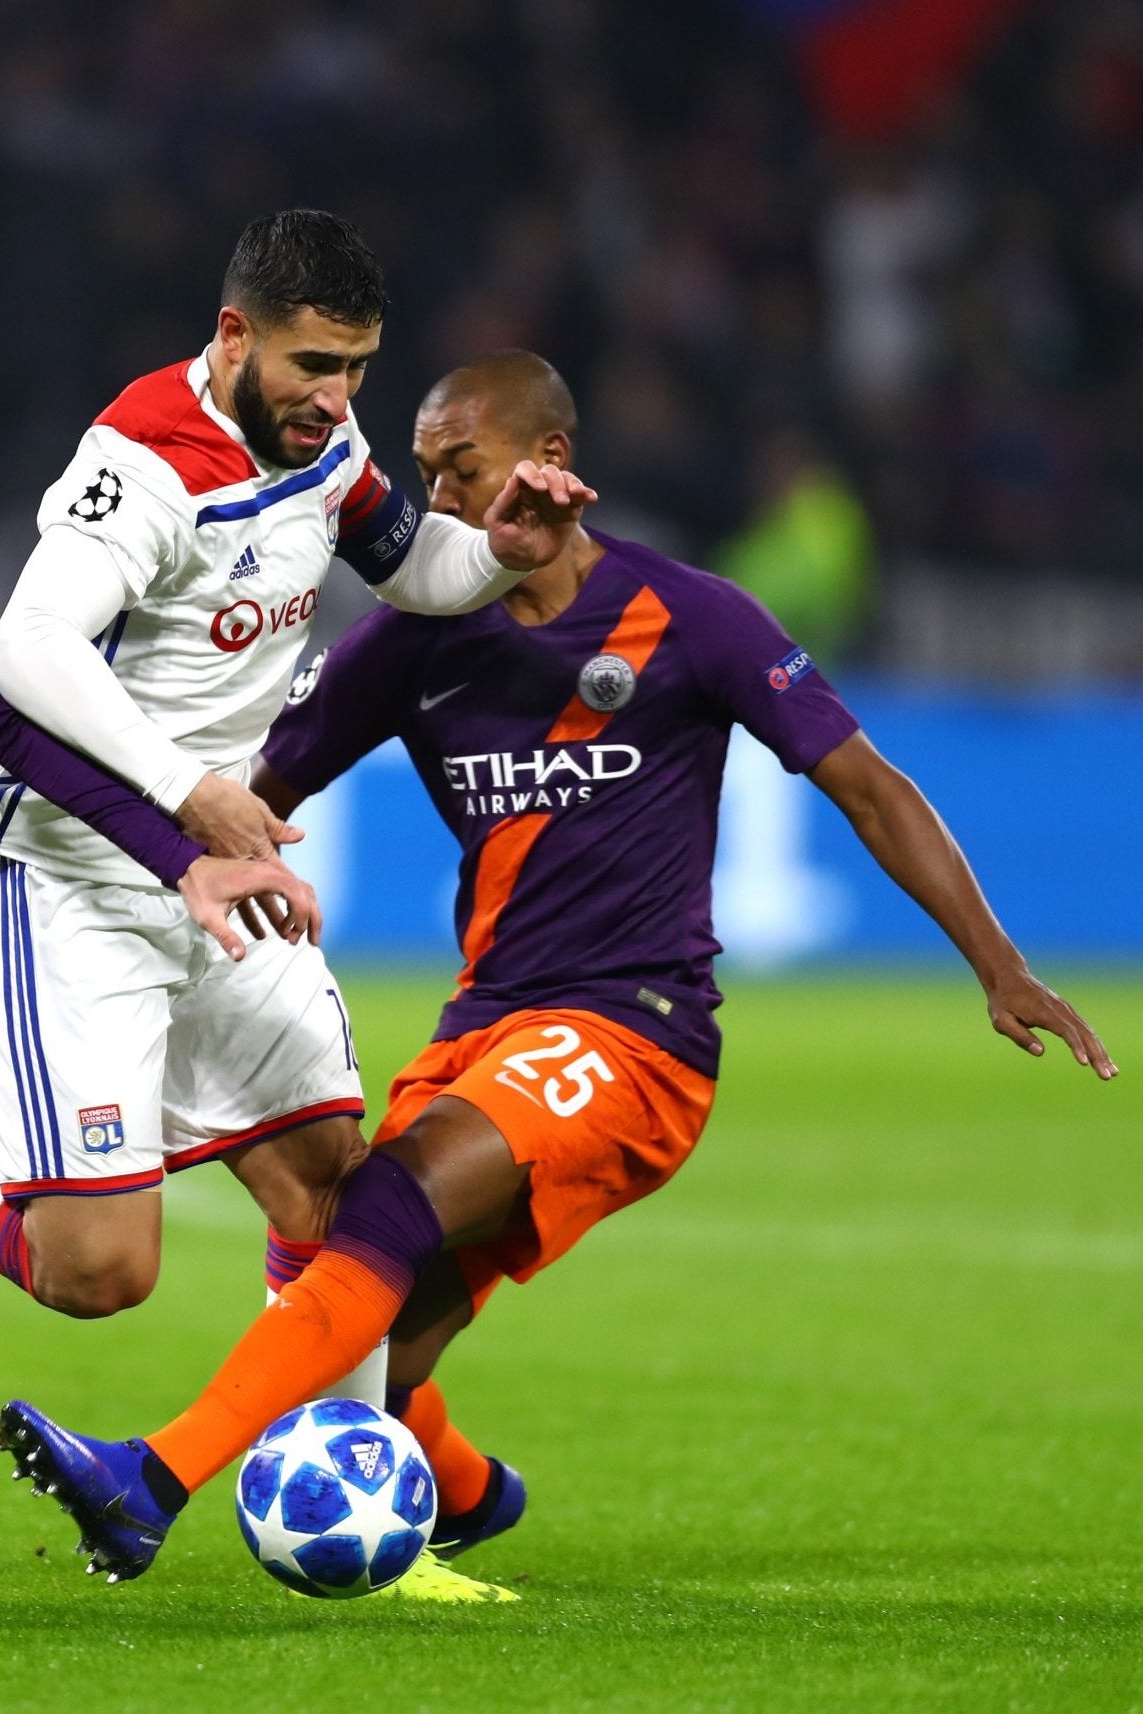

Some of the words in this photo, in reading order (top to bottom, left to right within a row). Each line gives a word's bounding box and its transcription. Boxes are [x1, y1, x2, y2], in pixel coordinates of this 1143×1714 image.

[229, 564, 261, 581] adidas
[442, 744, 642, 791] ETIHAD
[466, 786, 593, 816] AIRWAYS
[501, 1024, 615, 1118] 25
